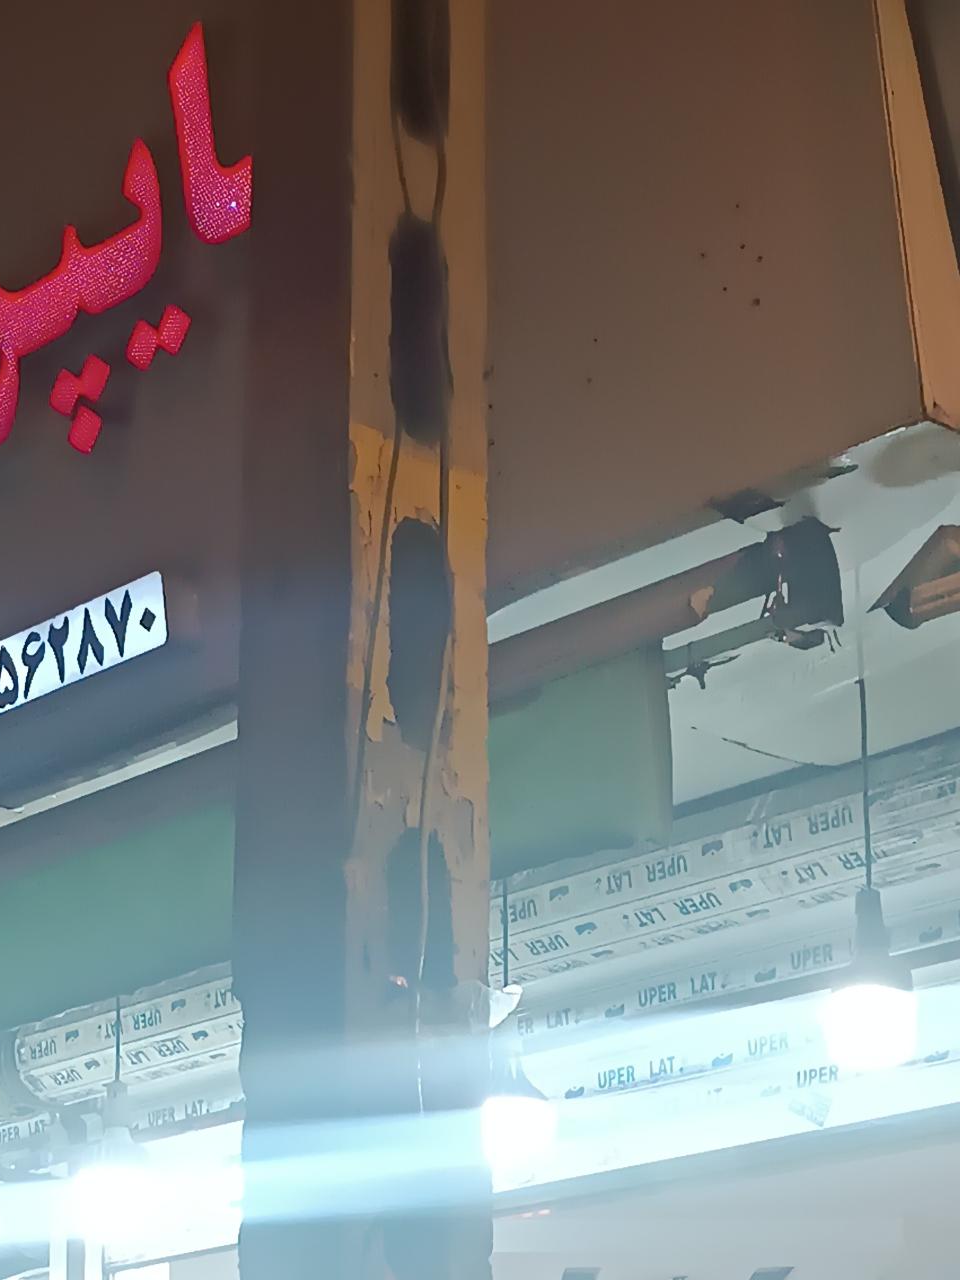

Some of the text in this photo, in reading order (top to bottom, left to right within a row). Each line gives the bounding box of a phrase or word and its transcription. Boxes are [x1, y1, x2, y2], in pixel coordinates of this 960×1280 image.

[806, 804, 853, 836] UPER
[645, 854, 688, 883] UPER
[638, 981, 677, 1007] UPER
[597, 1065, 635, 1088] UPER
